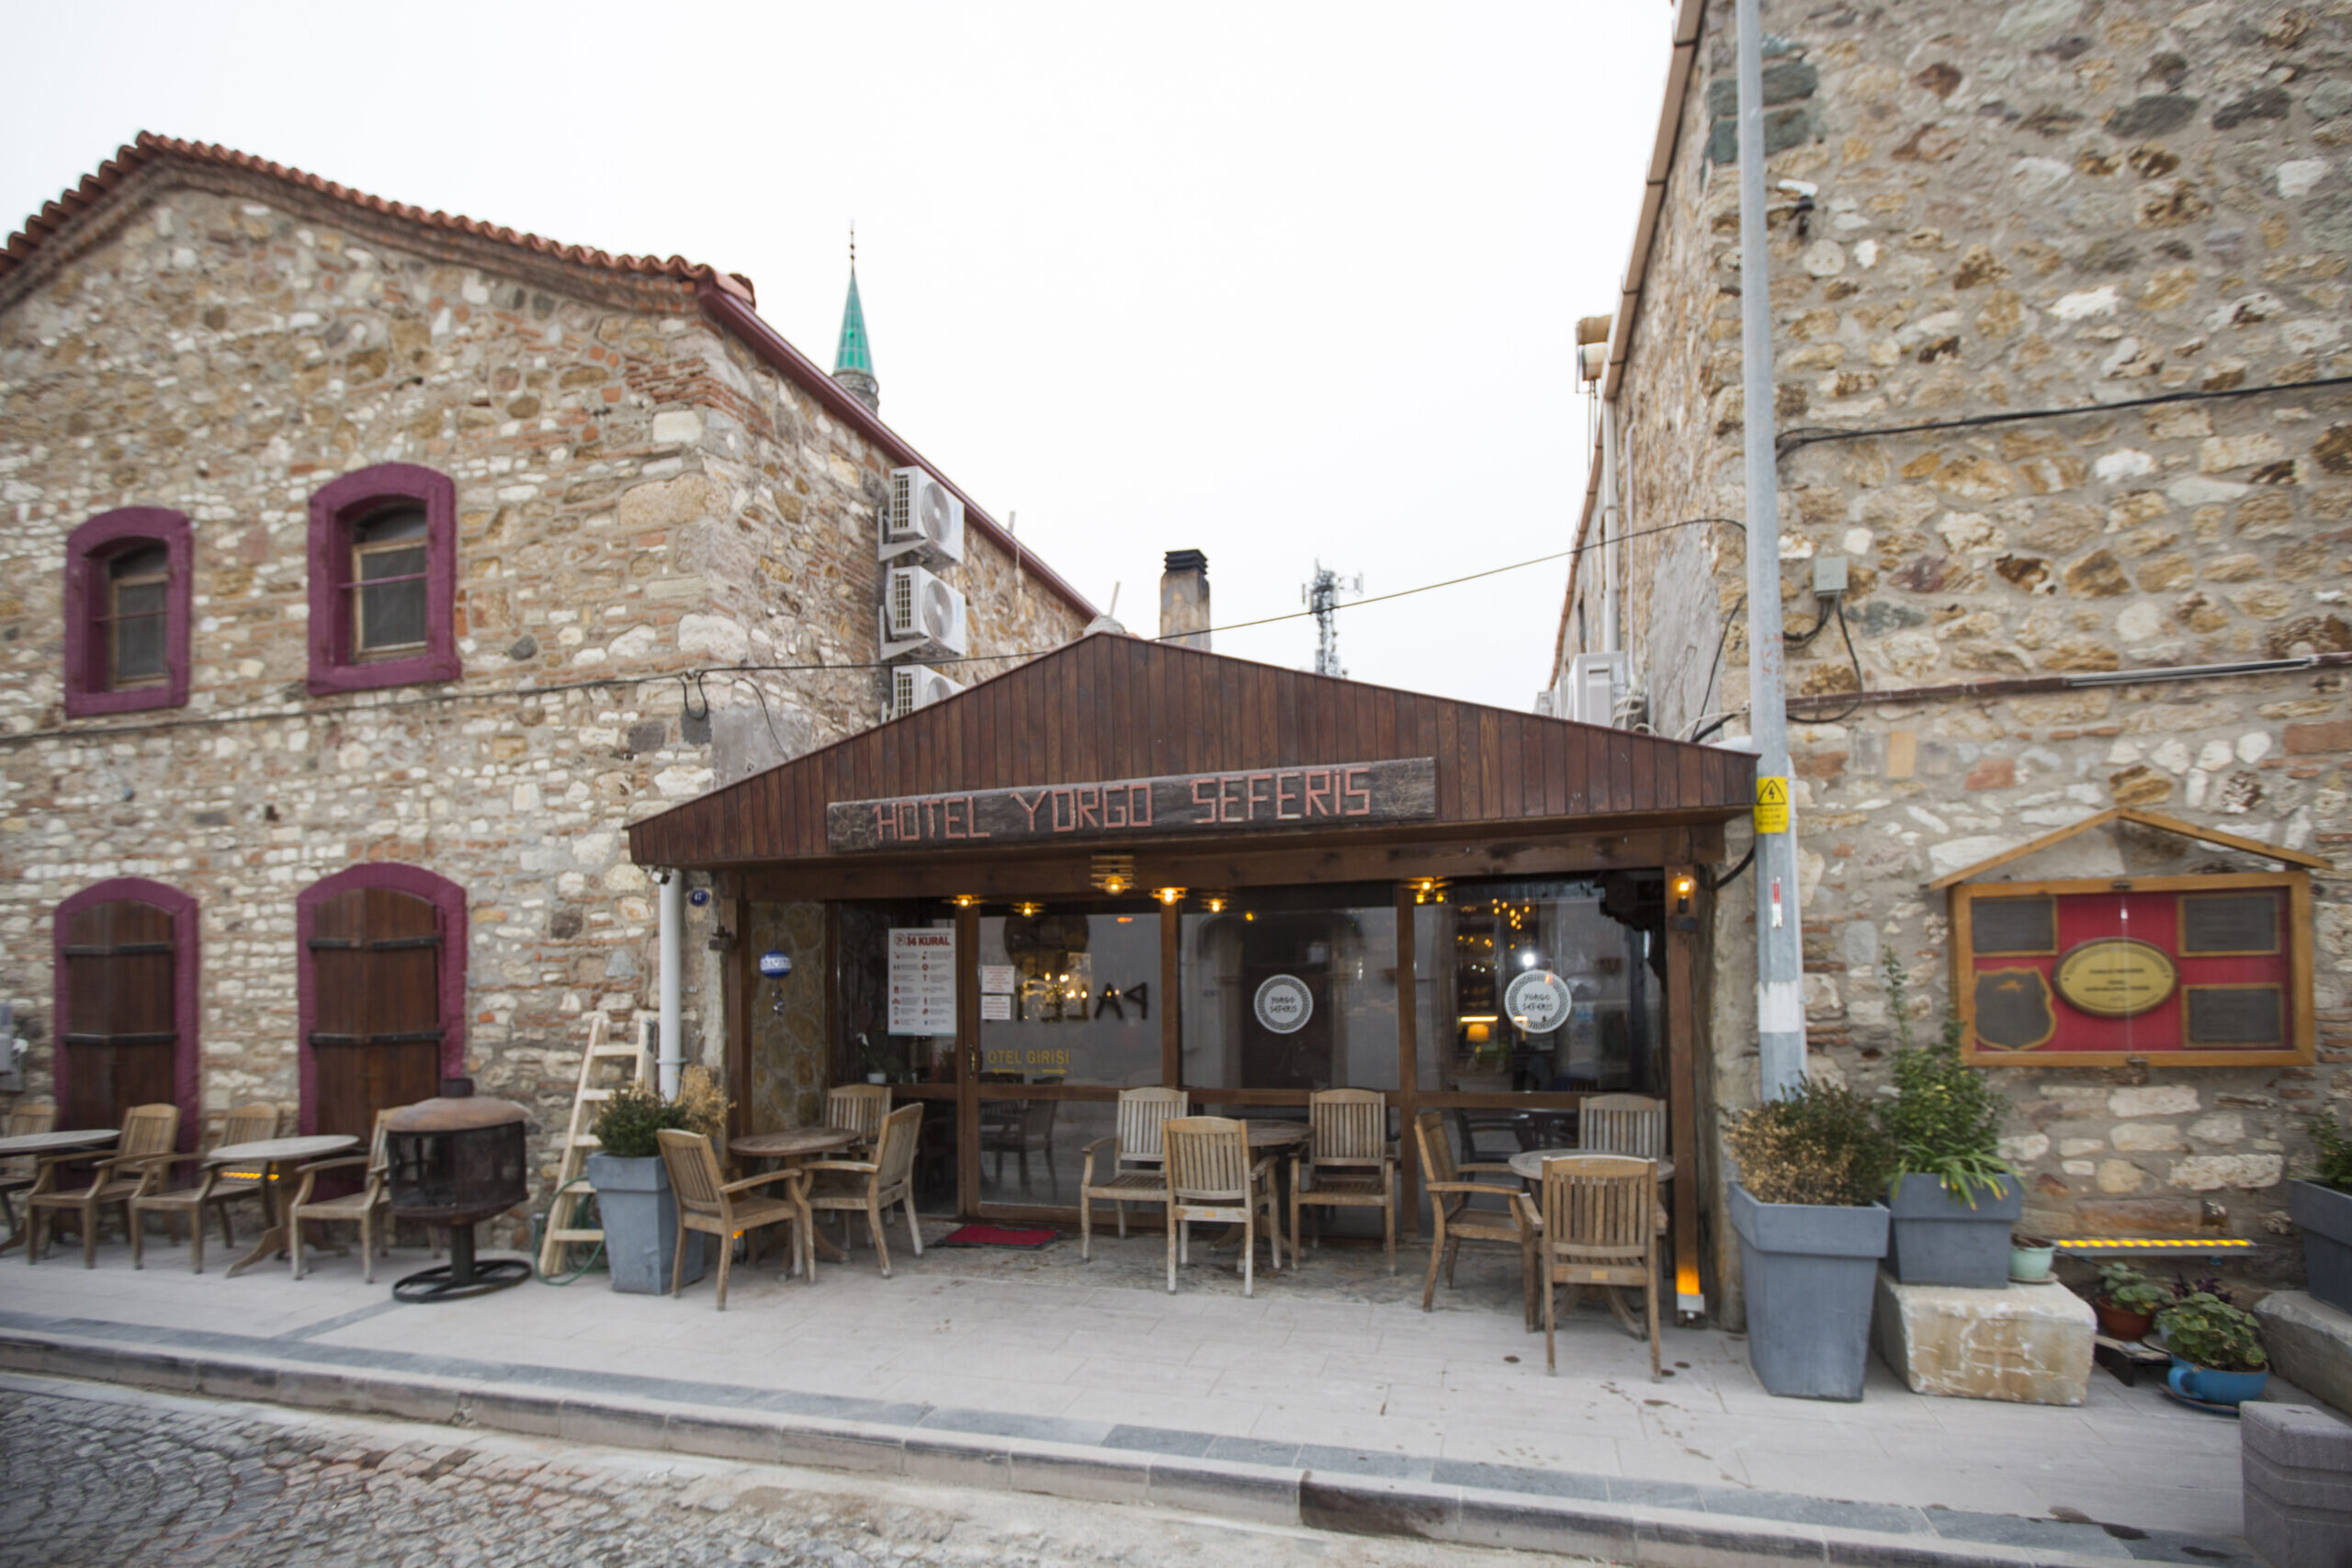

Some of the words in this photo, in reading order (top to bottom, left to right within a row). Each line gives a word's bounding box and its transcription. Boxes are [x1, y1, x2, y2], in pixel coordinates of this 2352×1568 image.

[872, 795, 991, 841] HOTEL
[1010, 784, 1153, 834] YORGO
[906, 936, 917, 947] 14
[919, 935, 951, 946] KURAL
[987, 1050, 1023, 1065] OTEL
